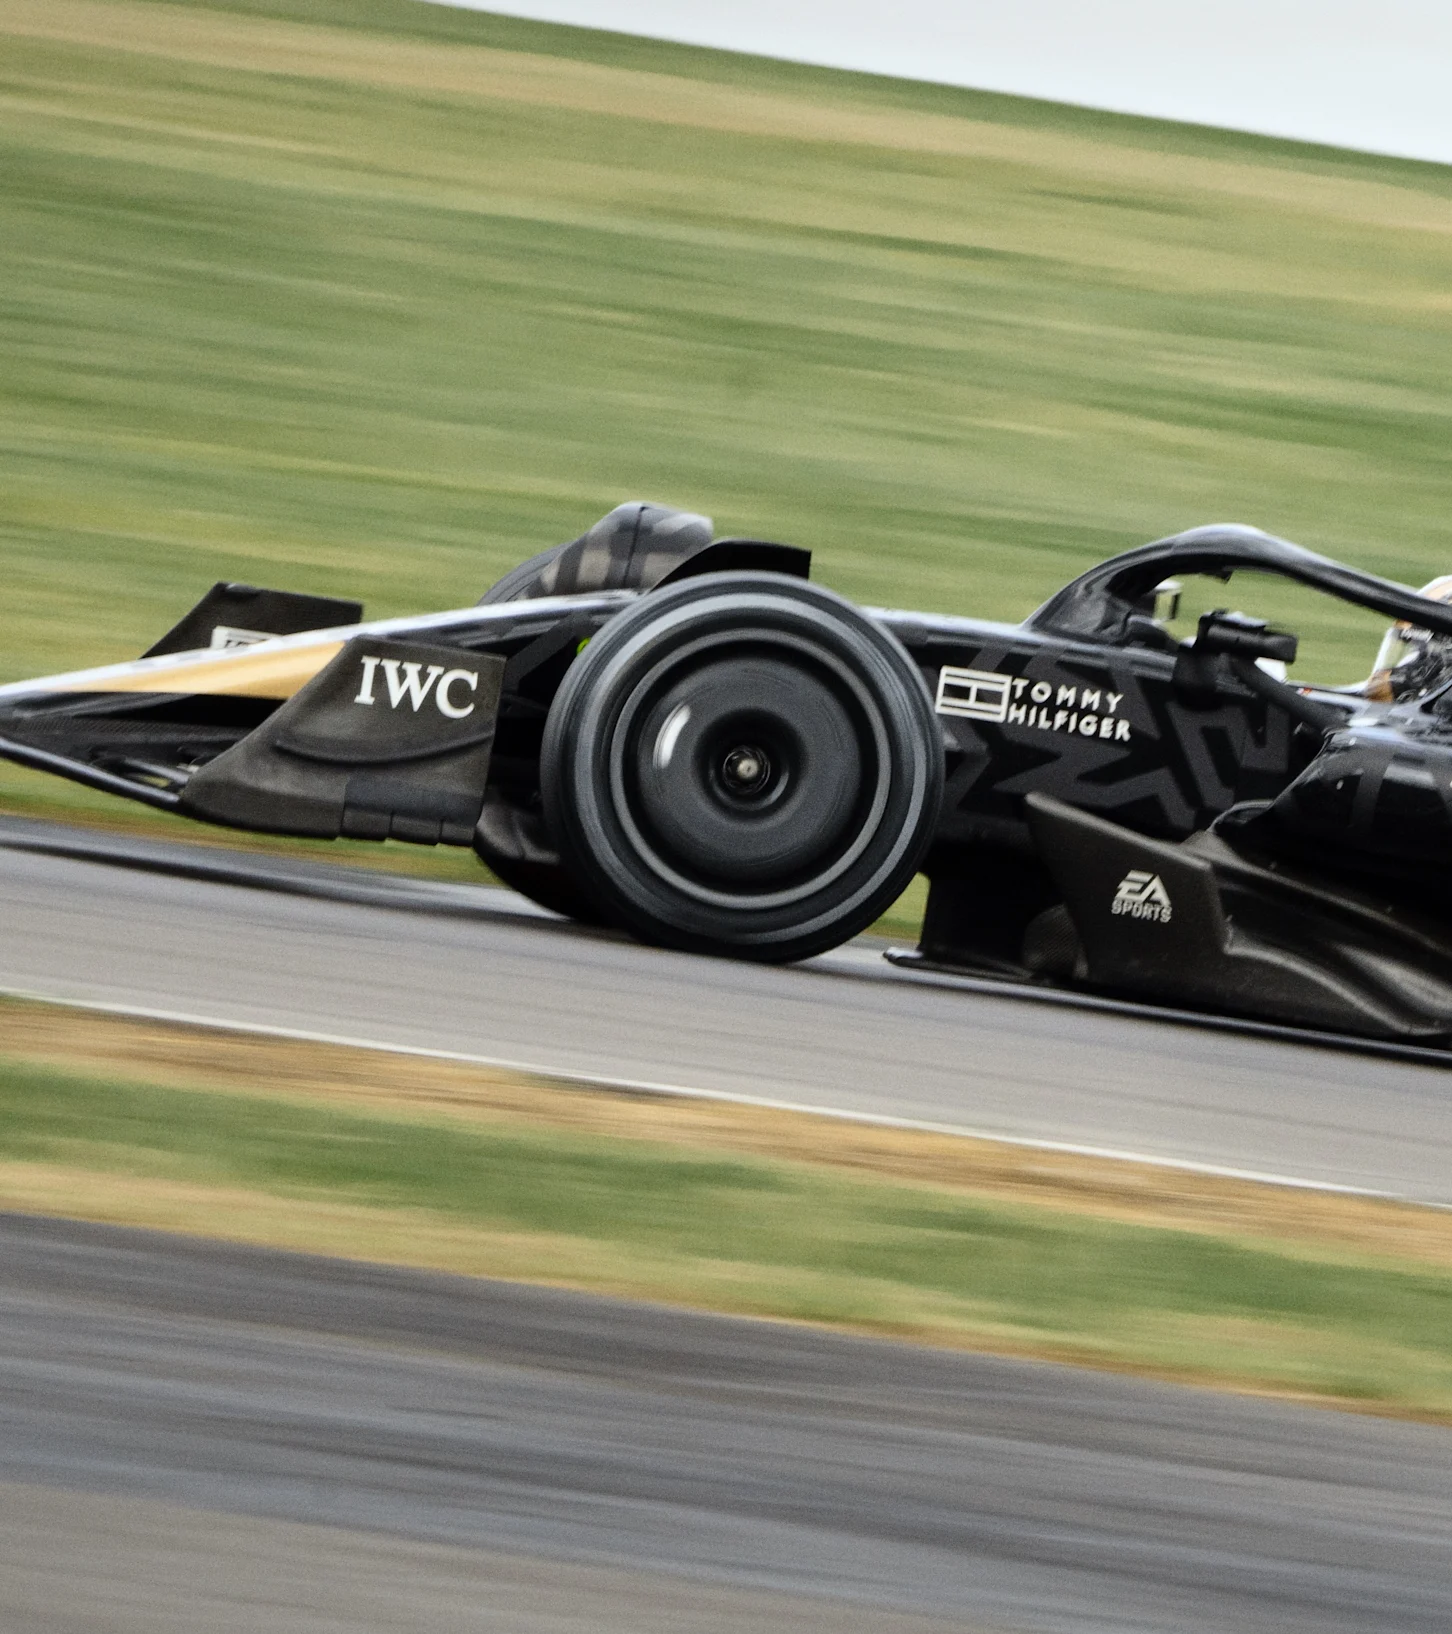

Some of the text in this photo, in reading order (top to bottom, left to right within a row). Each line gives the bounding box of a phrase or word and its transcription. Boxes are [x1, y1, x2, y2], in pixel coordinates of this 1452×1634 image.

[354, 655, 479, 719] IWC
[1011, 677, 1124, 714] TOMMY
[1007, 702, 1132, 742] HILFIGER
[1114, 869, 1171, 906] EA
[1111, 899, 1173, 924] SPORTS
